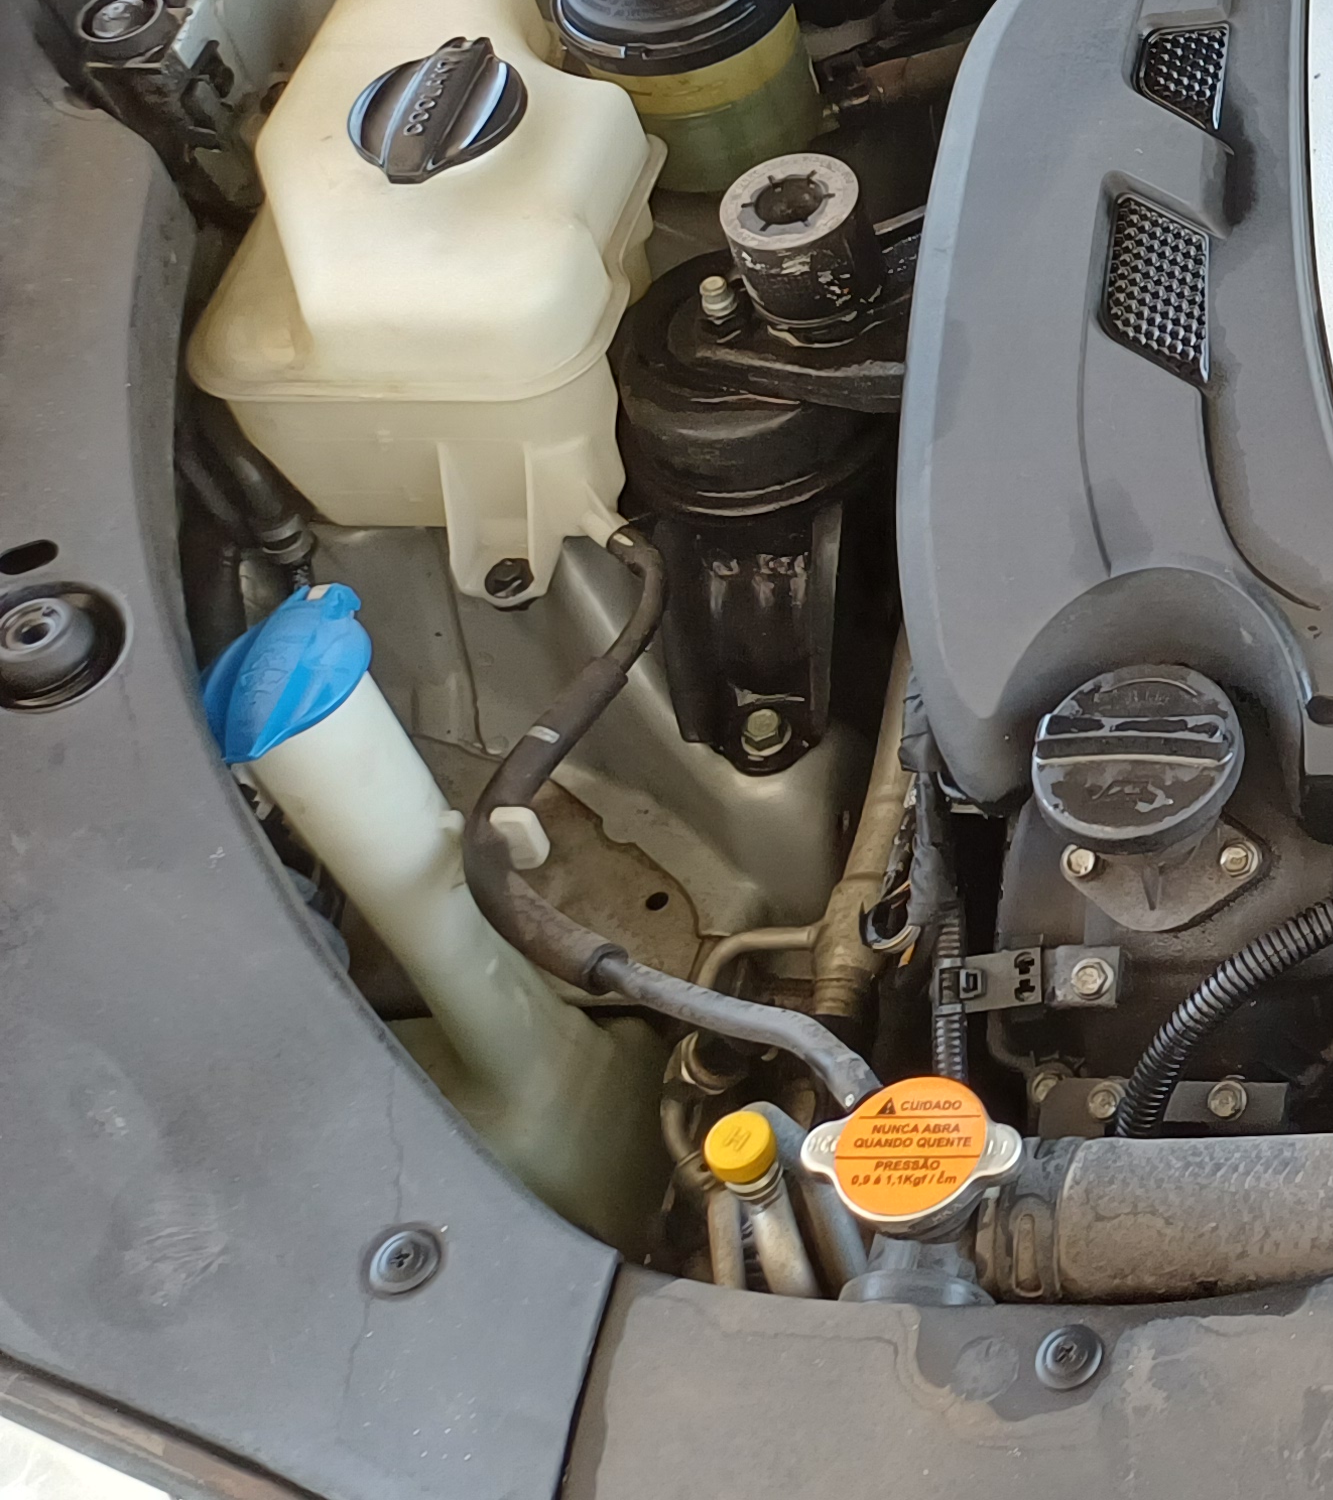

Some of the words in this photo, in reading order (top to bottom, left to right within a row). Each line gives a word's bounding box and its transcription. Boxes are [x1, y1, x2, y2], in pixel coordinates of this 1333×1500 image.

[900, 1100, 962, 1111] CUIDADO
[871, 1124, 919, 1135] NUNCA
[921, 1123, 961, 1134] ABRA
[853, 1137, 913, 1148] QUANDO
[916, 1136, 972, 1148] QUENTE
